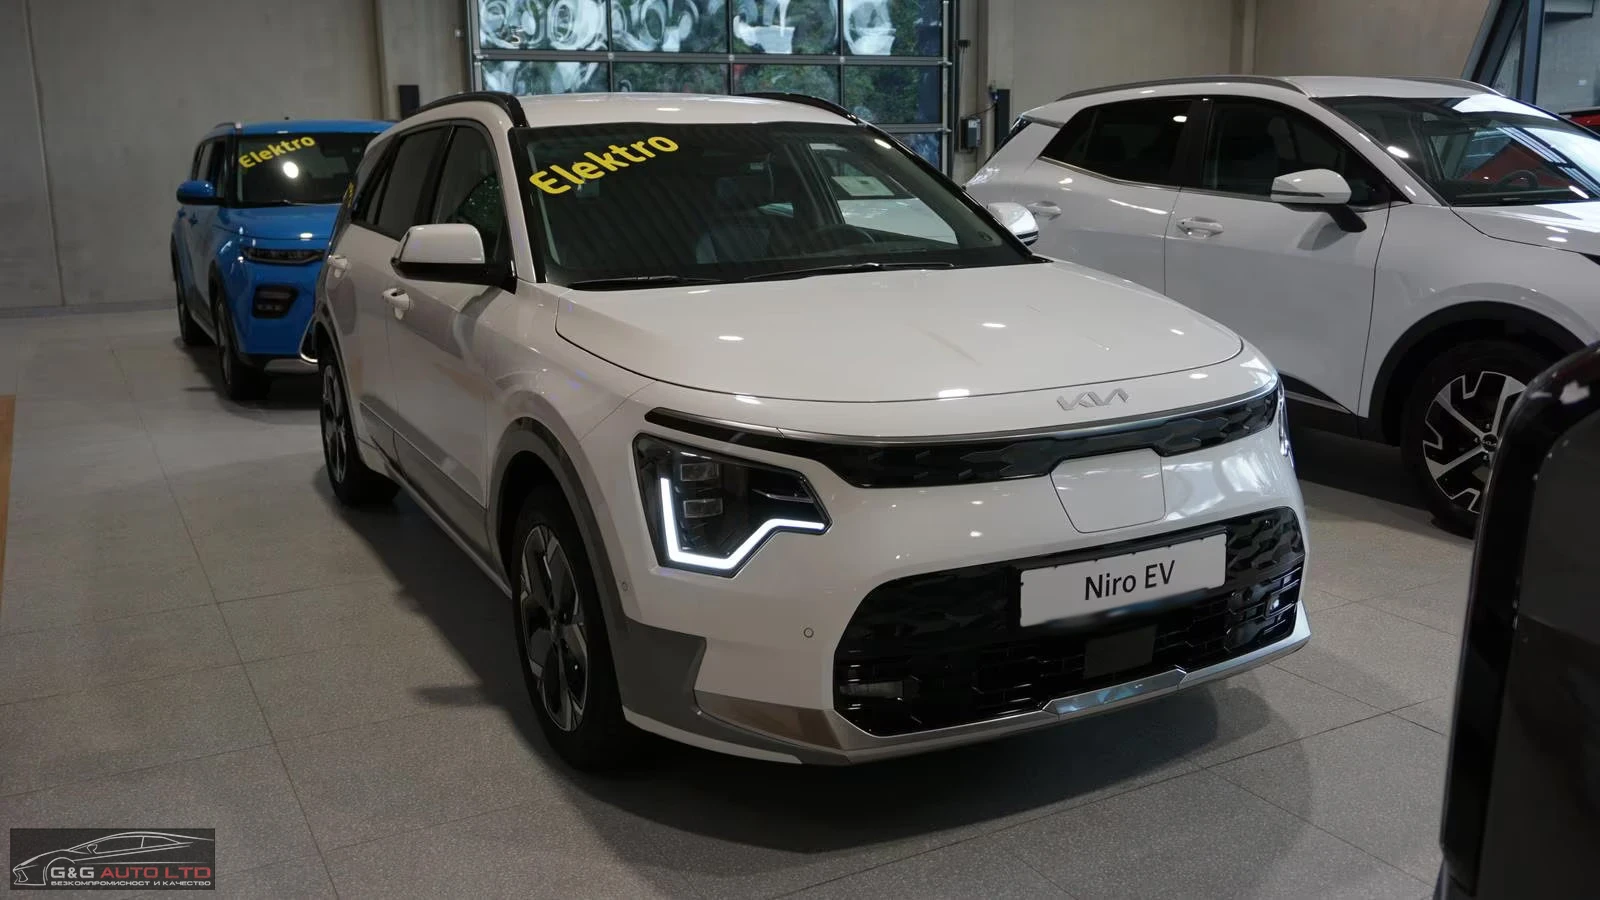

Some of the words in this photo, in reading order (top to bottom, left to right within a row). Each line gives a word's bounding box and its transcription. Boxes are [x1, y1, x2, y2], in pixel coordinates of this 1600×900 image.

[238, 136, 316, 169] Elektro
[528, 136, 679, 195] Elektro
[1084, 572, 1137, 601] Niro
[1144, 560, 1176, 589] EV
